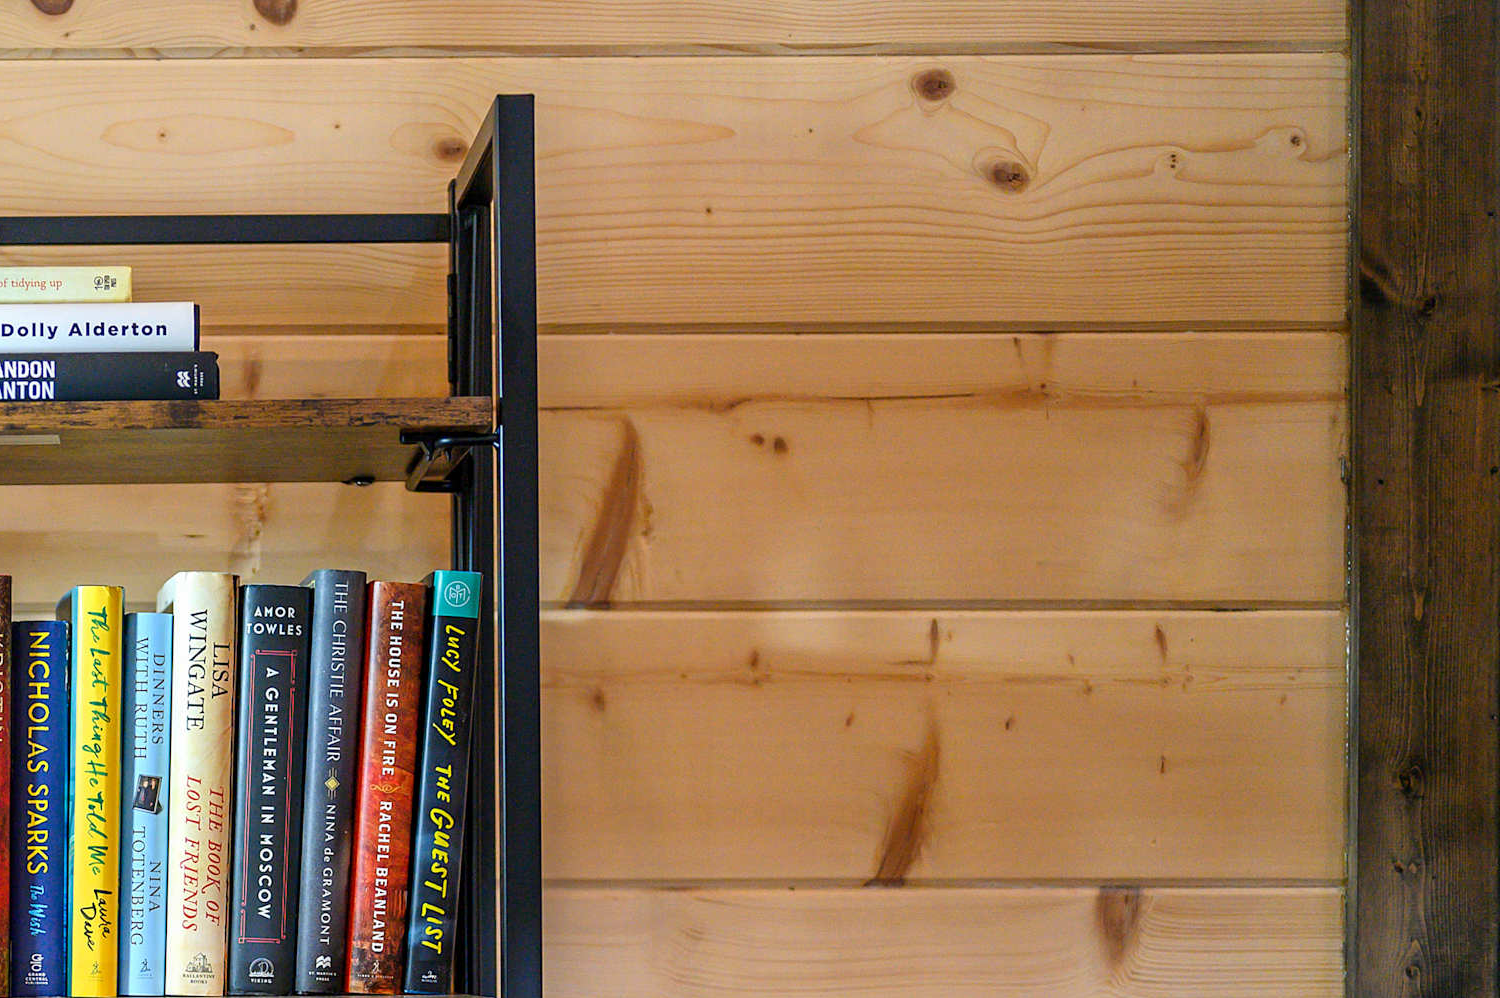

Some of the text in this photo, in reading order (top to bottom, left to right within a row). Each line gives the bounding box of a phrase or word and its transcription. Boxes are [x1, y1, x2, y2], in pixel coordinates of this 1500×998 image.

[1, 320, 168, 339] Dolly Alderton
[11, 278, 45, 291] tidying
[49, 279, 63, 291] up
[246, 623, 303, 636] TOWLES
[254, 605, 296, 619] AMOR
[133, 637, 149, 760] WITH RUTH
[151, 654, 166, 744] DINNERS
[186, 609, 207, 731] WINGATE
[210, 642, 230, 699] LISA
[326, 581, 349, 762] THE CHRISTIE AFFAIR
[381, 600, 405, 776] THE HOUSE IS ON FIRE
[433, 624, 466, 745] LUCY FOLEY
[27, 630, 50, 874] NICHOLAS SPARKS
[83, 607, 112, 875] The Last Thing He Told Me
[257, 667, 279, 920] A GENTLEMAN IN MOSCOW
[435, 764, 452, 802] THE
[130, 826, 145, 946] TOTENBERG
[148, 861, 162, 912] NINA
[179, 775, 202, 932] LOST FRIENDS
[202, 786, 224, 926] THE BOOK OF
[319, 804, 337, 945] NINA de GRAMONT
[371, 800, 393, 952] RACHEL BEANLAND
[424, 807, 455, 898] GUEST
[29, 884, 48, 936] The Wish
[80, 903, 97, 951] Dave
[93, 888, 112, 939] Laura
[420, 903, 445, 953] LIST
